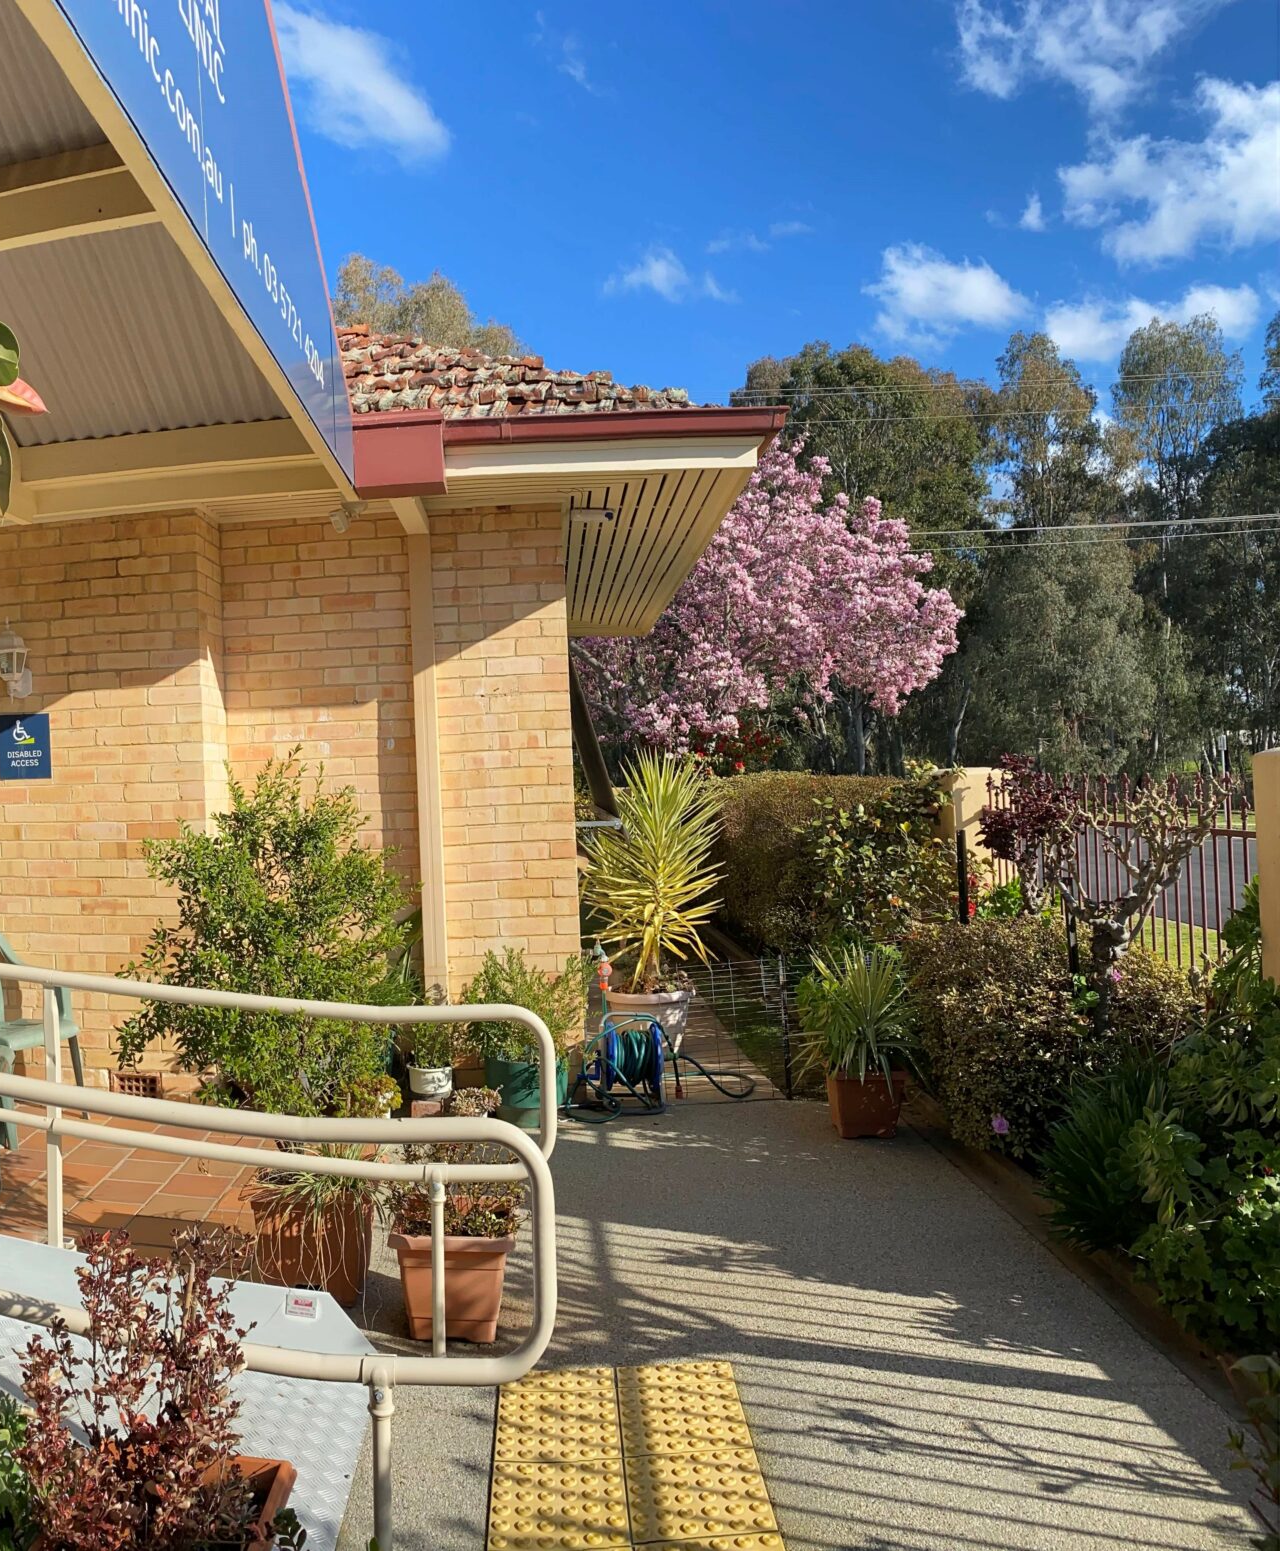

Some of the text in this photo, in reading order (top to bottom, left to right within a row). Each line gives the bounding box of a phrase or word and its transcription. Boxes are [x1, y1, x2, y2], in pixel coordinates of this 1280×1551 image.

[118, 0, 224, 205] nic.com.au
[242, 218, 262, 276] ph.
[263, 252, 278, 305] 03
[280, 282, 303, 350] 5721
[304, 333, 325, 391] 4204
[7, 749, 42, 759] DISABLED
[10, 758, 39, 767] ACCESS
